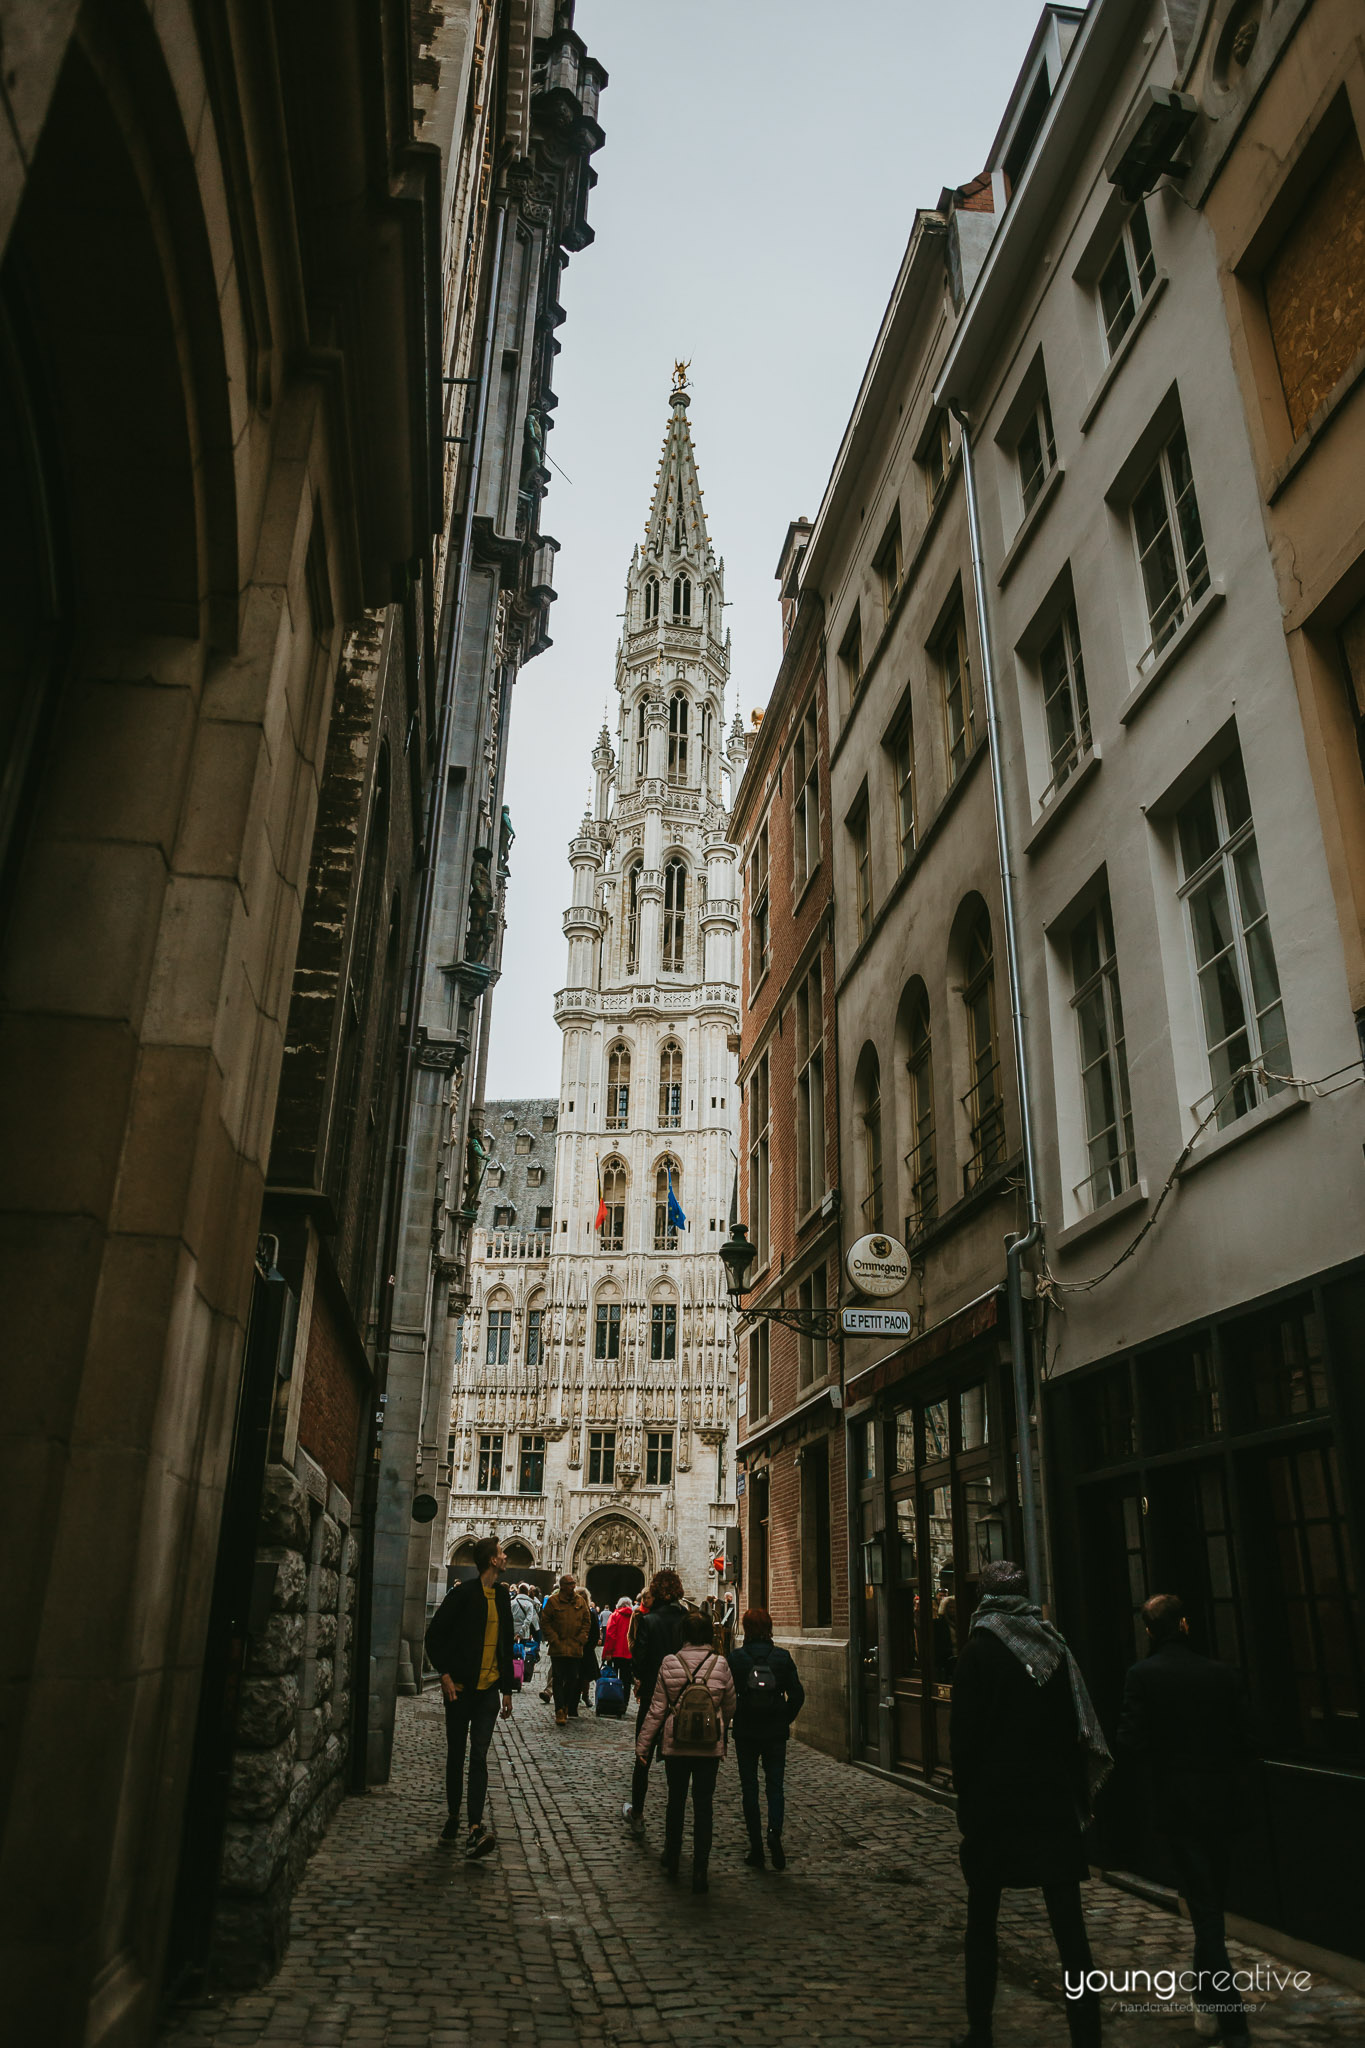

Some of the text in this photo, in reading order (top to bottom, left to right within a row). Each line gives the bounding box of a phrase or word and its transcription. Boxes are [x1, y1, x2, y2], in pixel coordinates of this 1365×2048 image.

[853, 1259, 907, 1276] Ommegang
[845, 1314, 908, 1329] LE PETIT PAON
